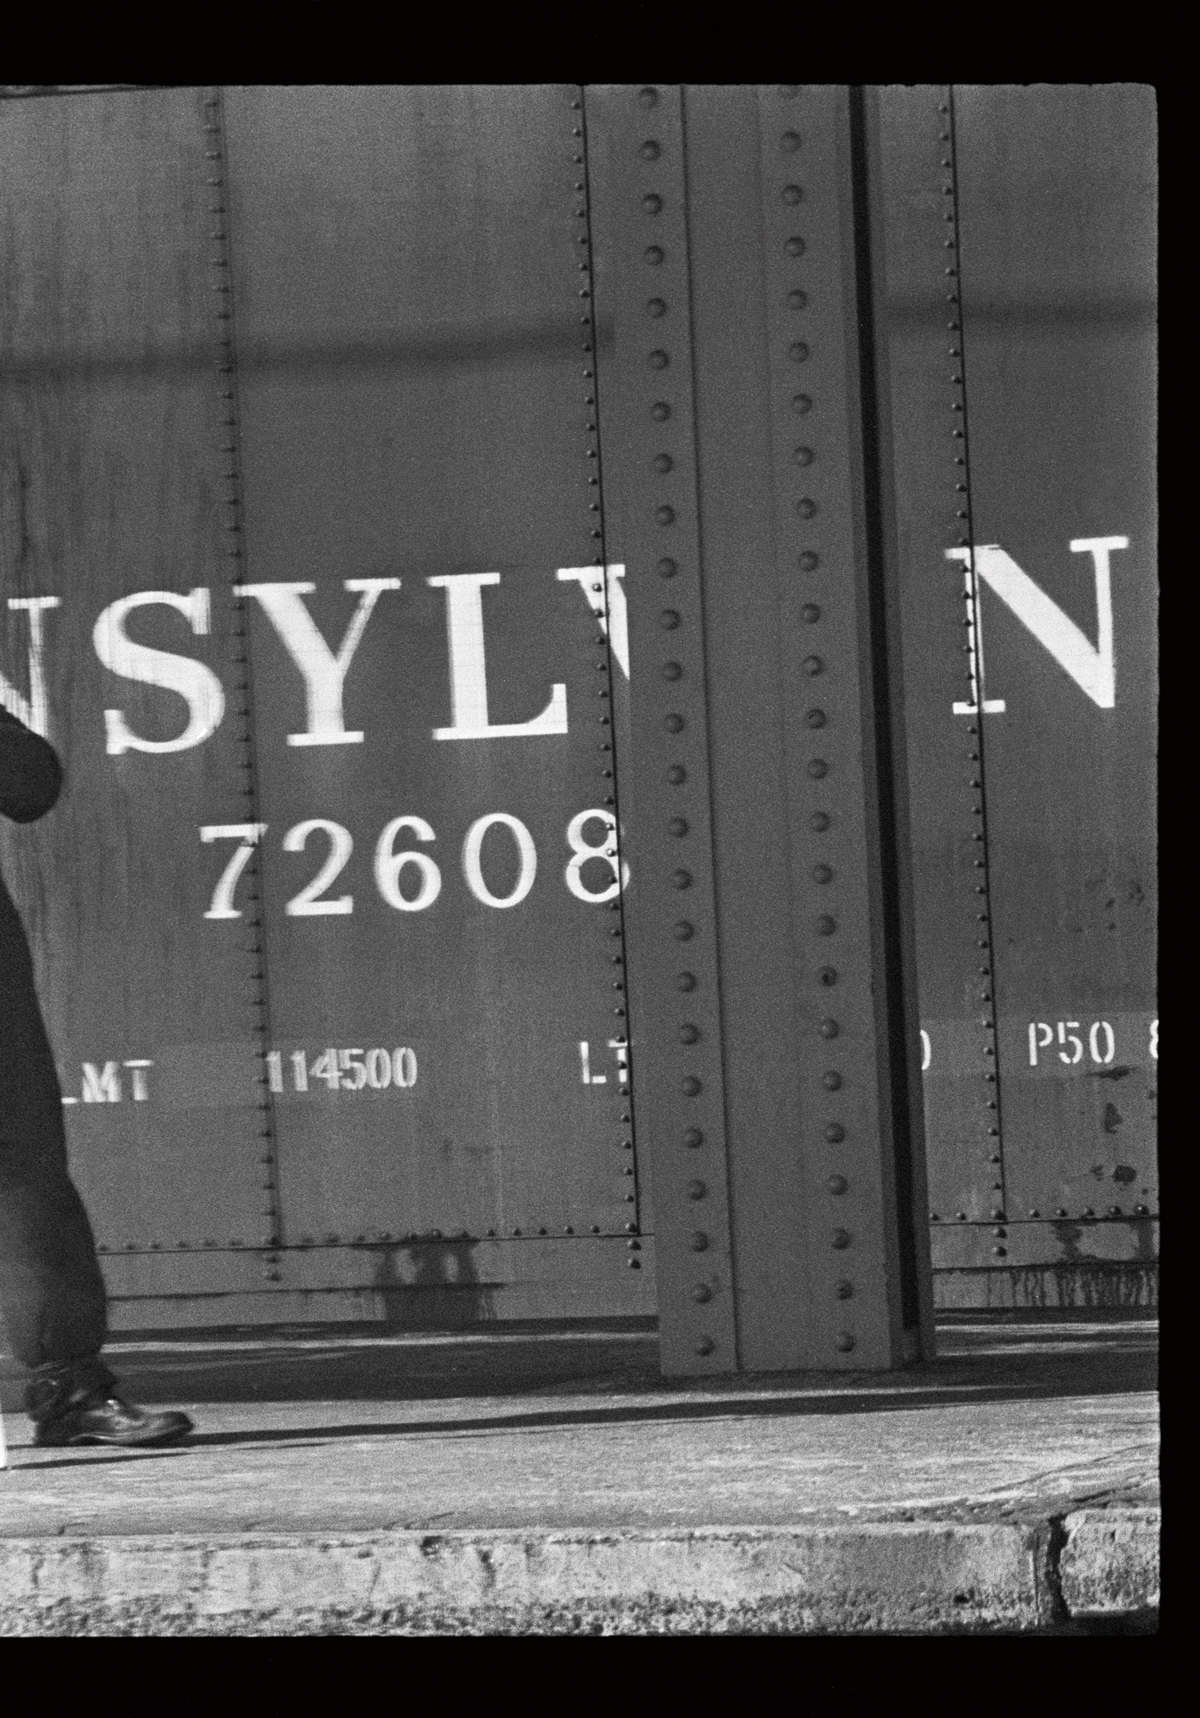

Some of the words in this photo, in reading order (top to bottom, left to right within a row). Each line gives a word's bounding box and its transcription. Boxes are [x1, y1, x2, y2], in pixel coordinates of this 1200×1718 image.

[198, 809, 630, 919] 72608
[61, 1060, 153, 1104] MT
[266, 1046, 418, 1092] 114500
[1028, 1021, 1115, 1066] P50
